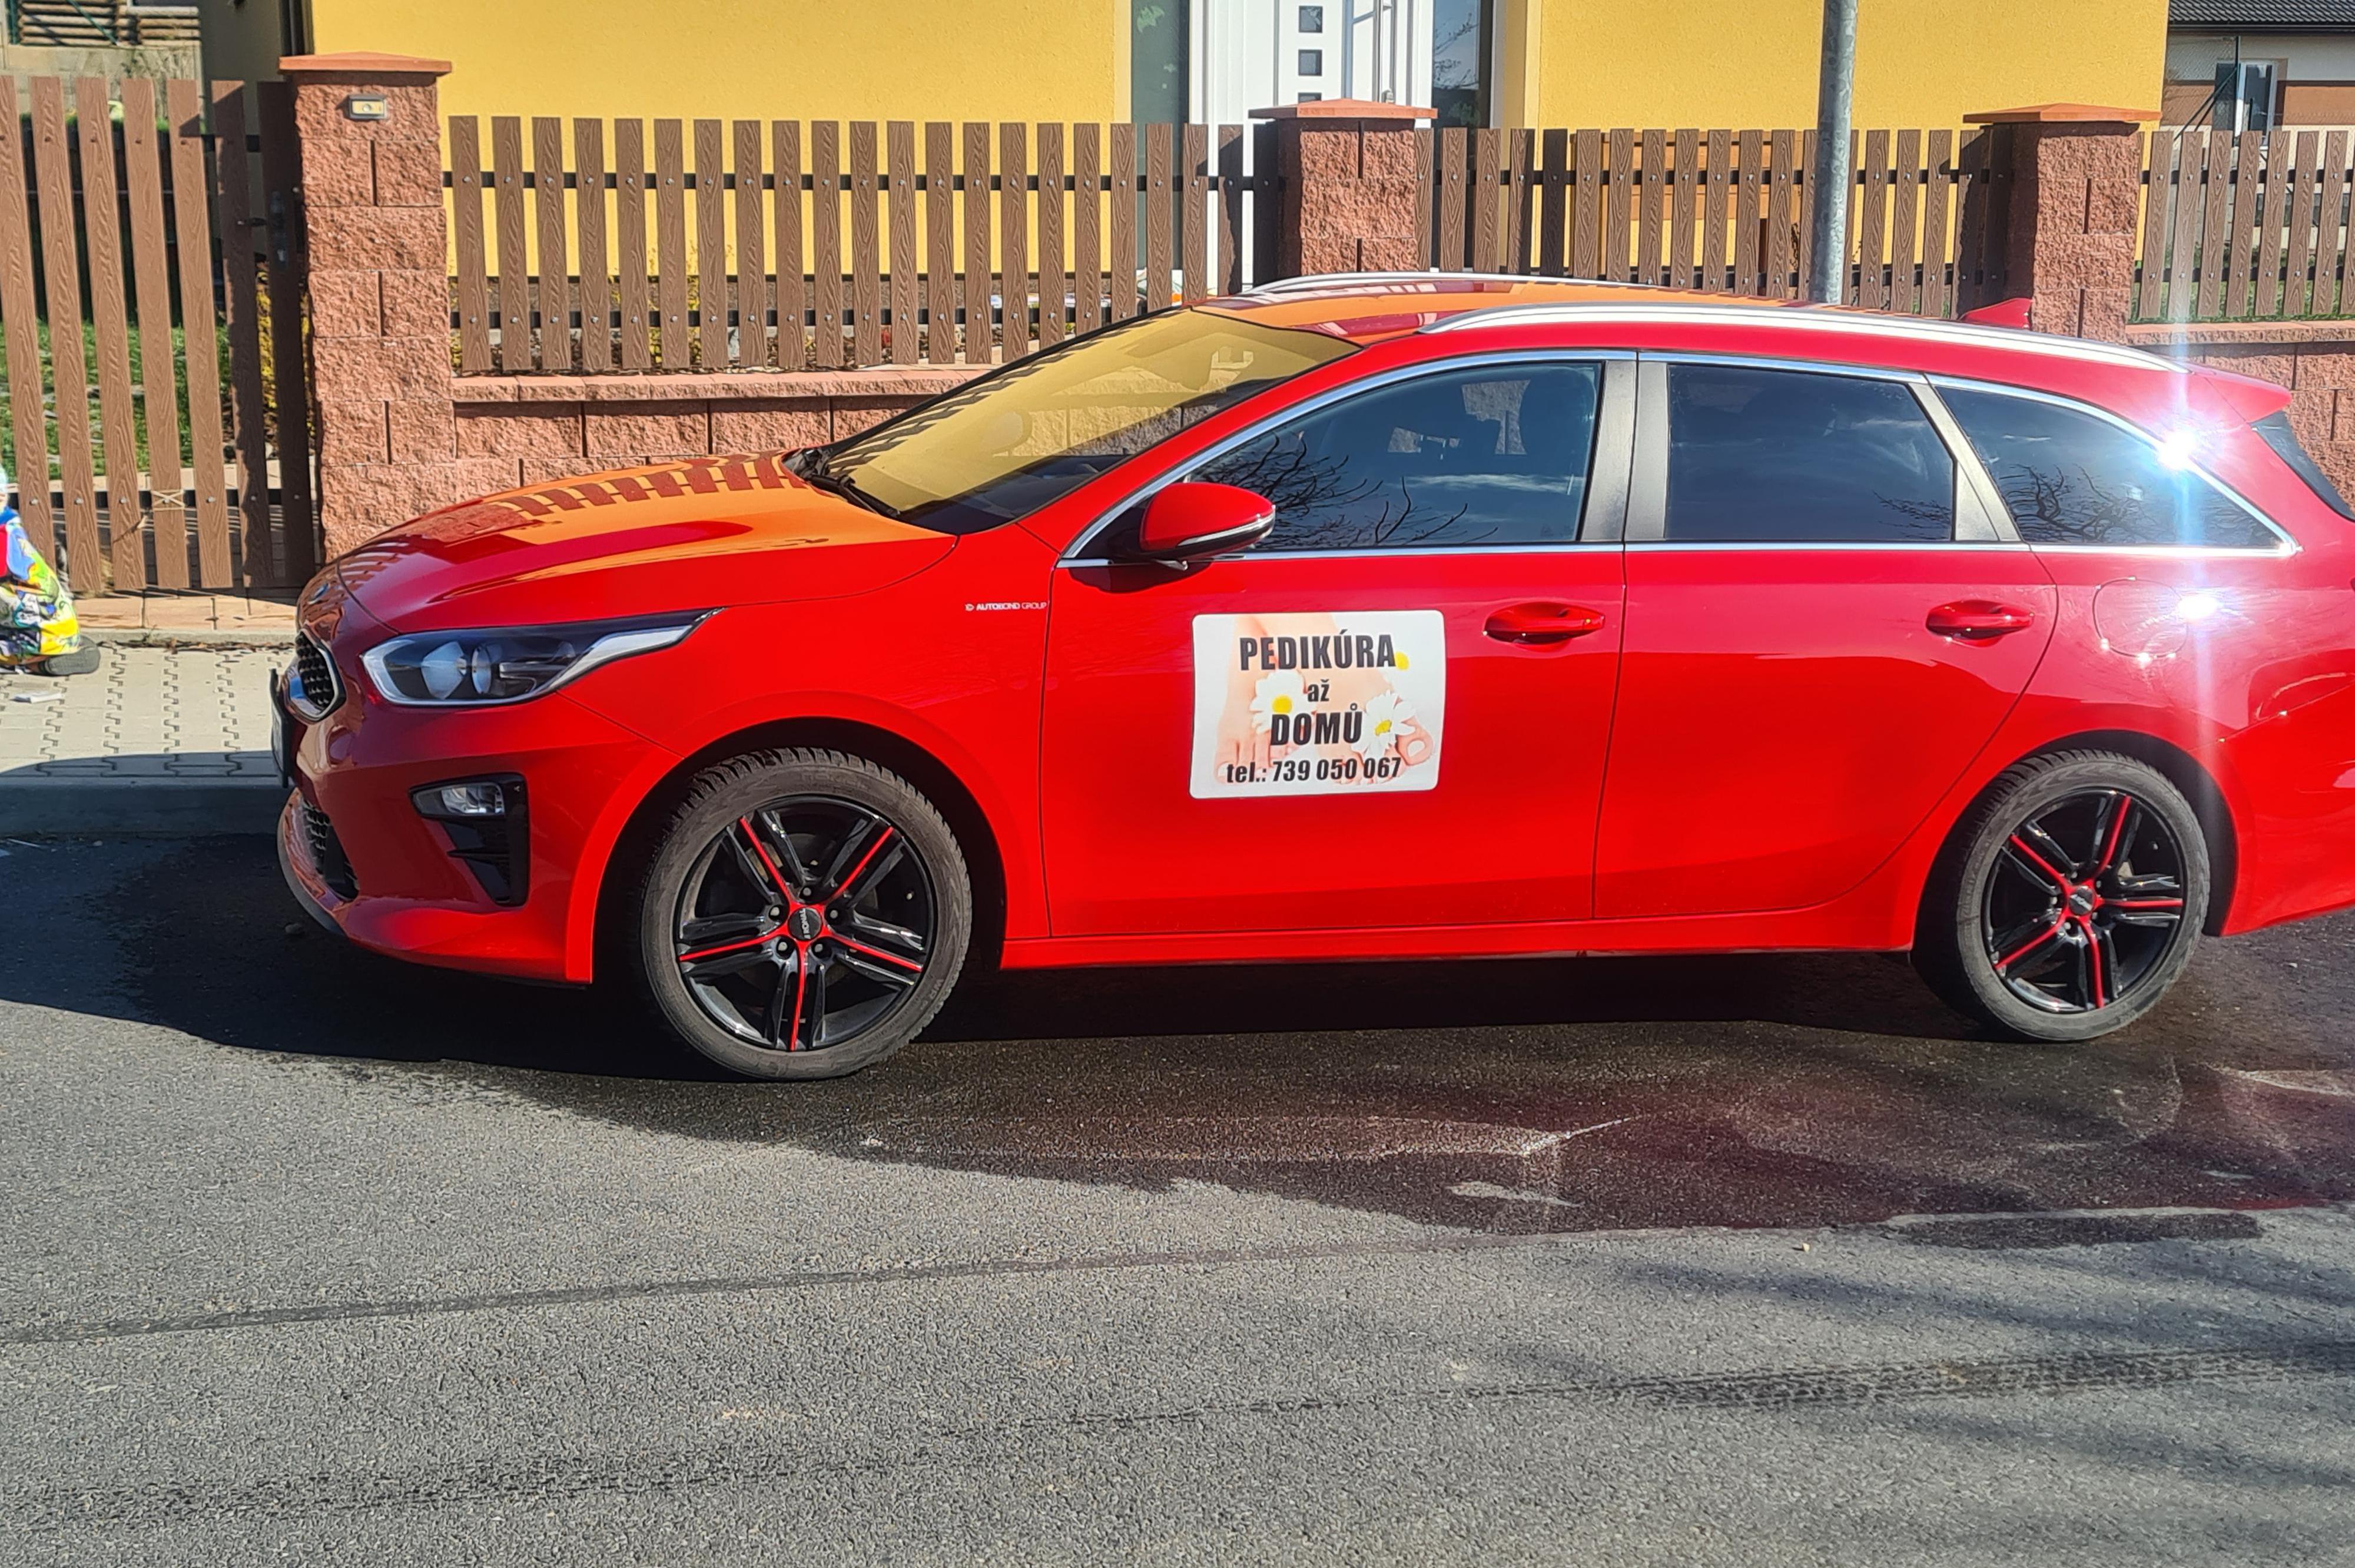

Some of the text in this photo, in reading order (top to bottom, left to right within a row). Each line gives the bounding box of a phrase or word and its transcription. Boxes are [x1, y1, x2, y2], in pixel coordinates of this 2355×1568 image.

[1239, 629, 1396, 671] PEDIKÚRA
[1307, 679, 1330, 702] až
[1271, 703, 1362, 745] DOMŮ
[1226, 757, 1402, 783] tel.: 739 050 067
